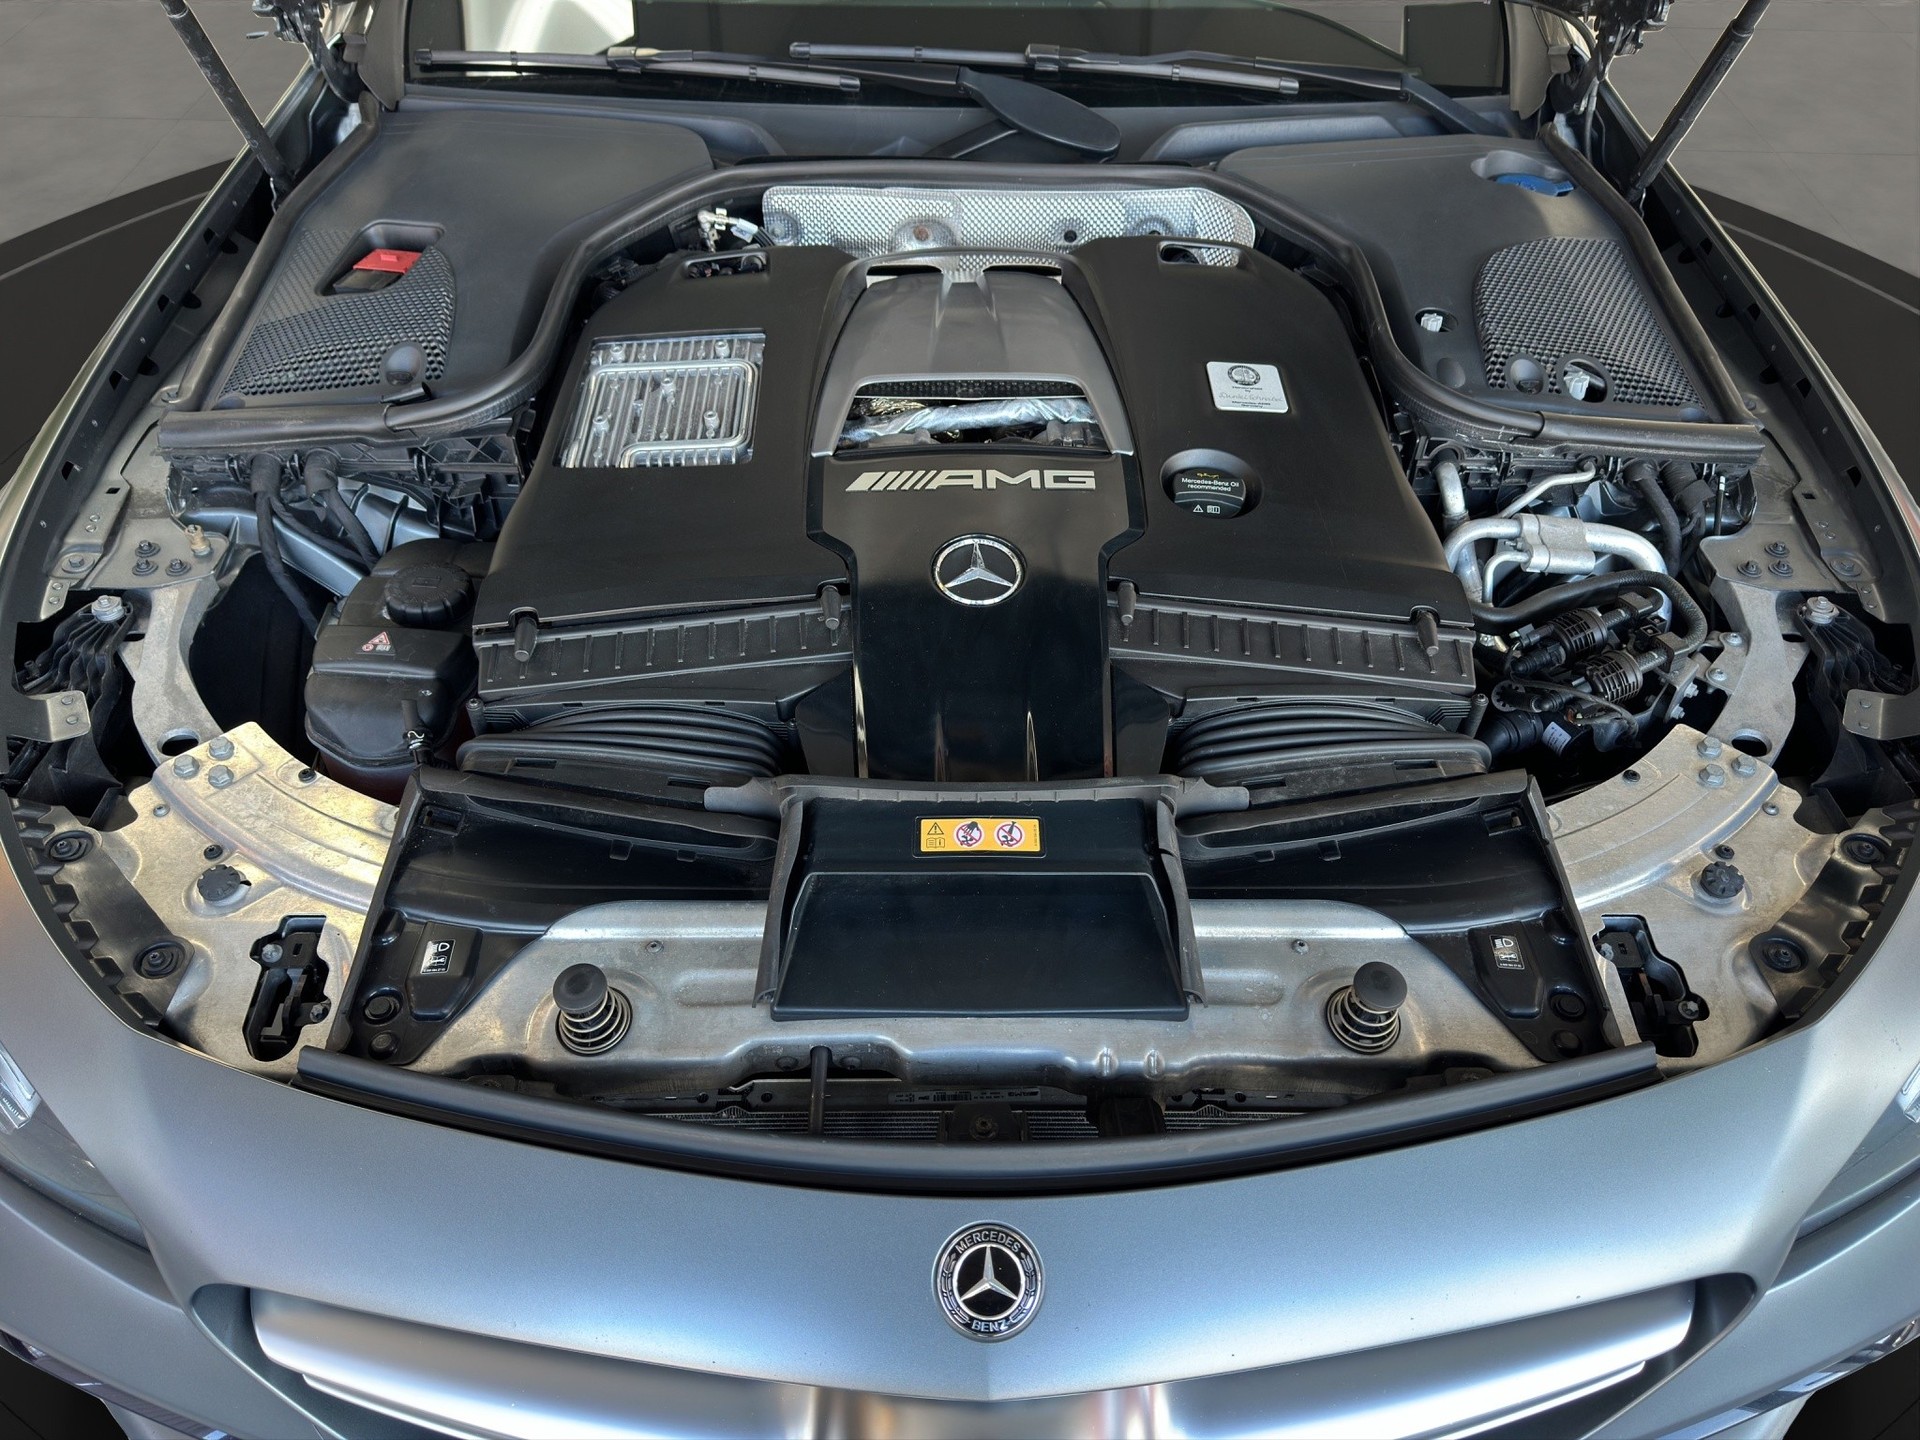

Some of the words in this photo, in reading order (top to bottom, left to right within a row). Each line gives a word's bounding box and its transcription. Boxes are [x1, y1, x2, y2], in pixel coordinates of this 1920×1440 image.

[925, 469, 1096, 490] AMG
[1181, 477, 1229, 487] Mercedes-Benz
[1187, 483, 1231, 492] recommended
[955, 1230, 1021, 1254] MERCEDES
[971, 1319, 1009, 1333] BENZ
